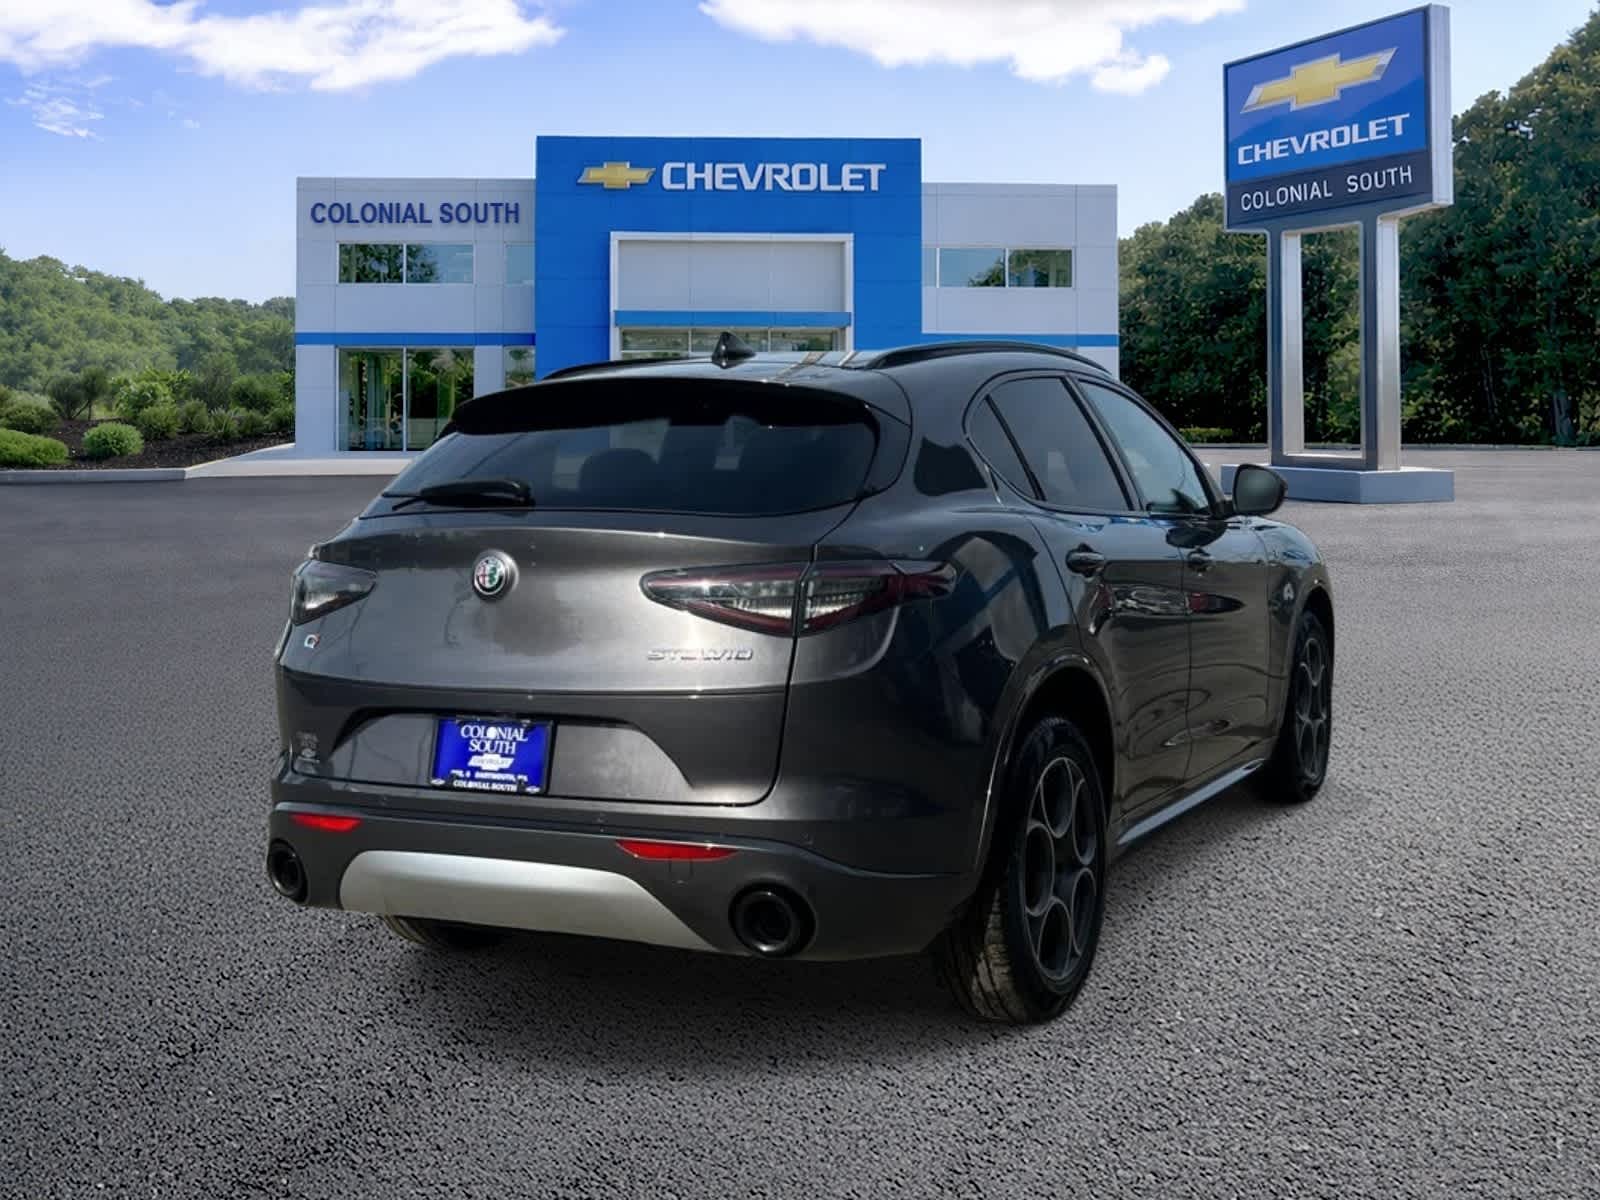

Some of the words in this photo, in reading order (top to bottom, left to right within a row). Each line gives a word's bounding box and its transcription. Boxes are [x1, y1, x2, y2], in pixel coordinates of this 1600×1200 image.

[1237, 113, 1410, 165] CHEVROLET
[661, 161, 887, 193] CHEVROLET
[1240, 180, 1332, 211] COLONIAL
[1346, 165, 1412, 193] SOUTH
[310, 201, 433, 225] COLONIAL
[439, 201, 520, 225] SOUTH
[460, 724, 528, 742] COLONIAL
[468, 738, 517, 755] SOUTH
[452, 780, 490, 790] COLONIAL
[491, 782, 518, 792] SOUTH
